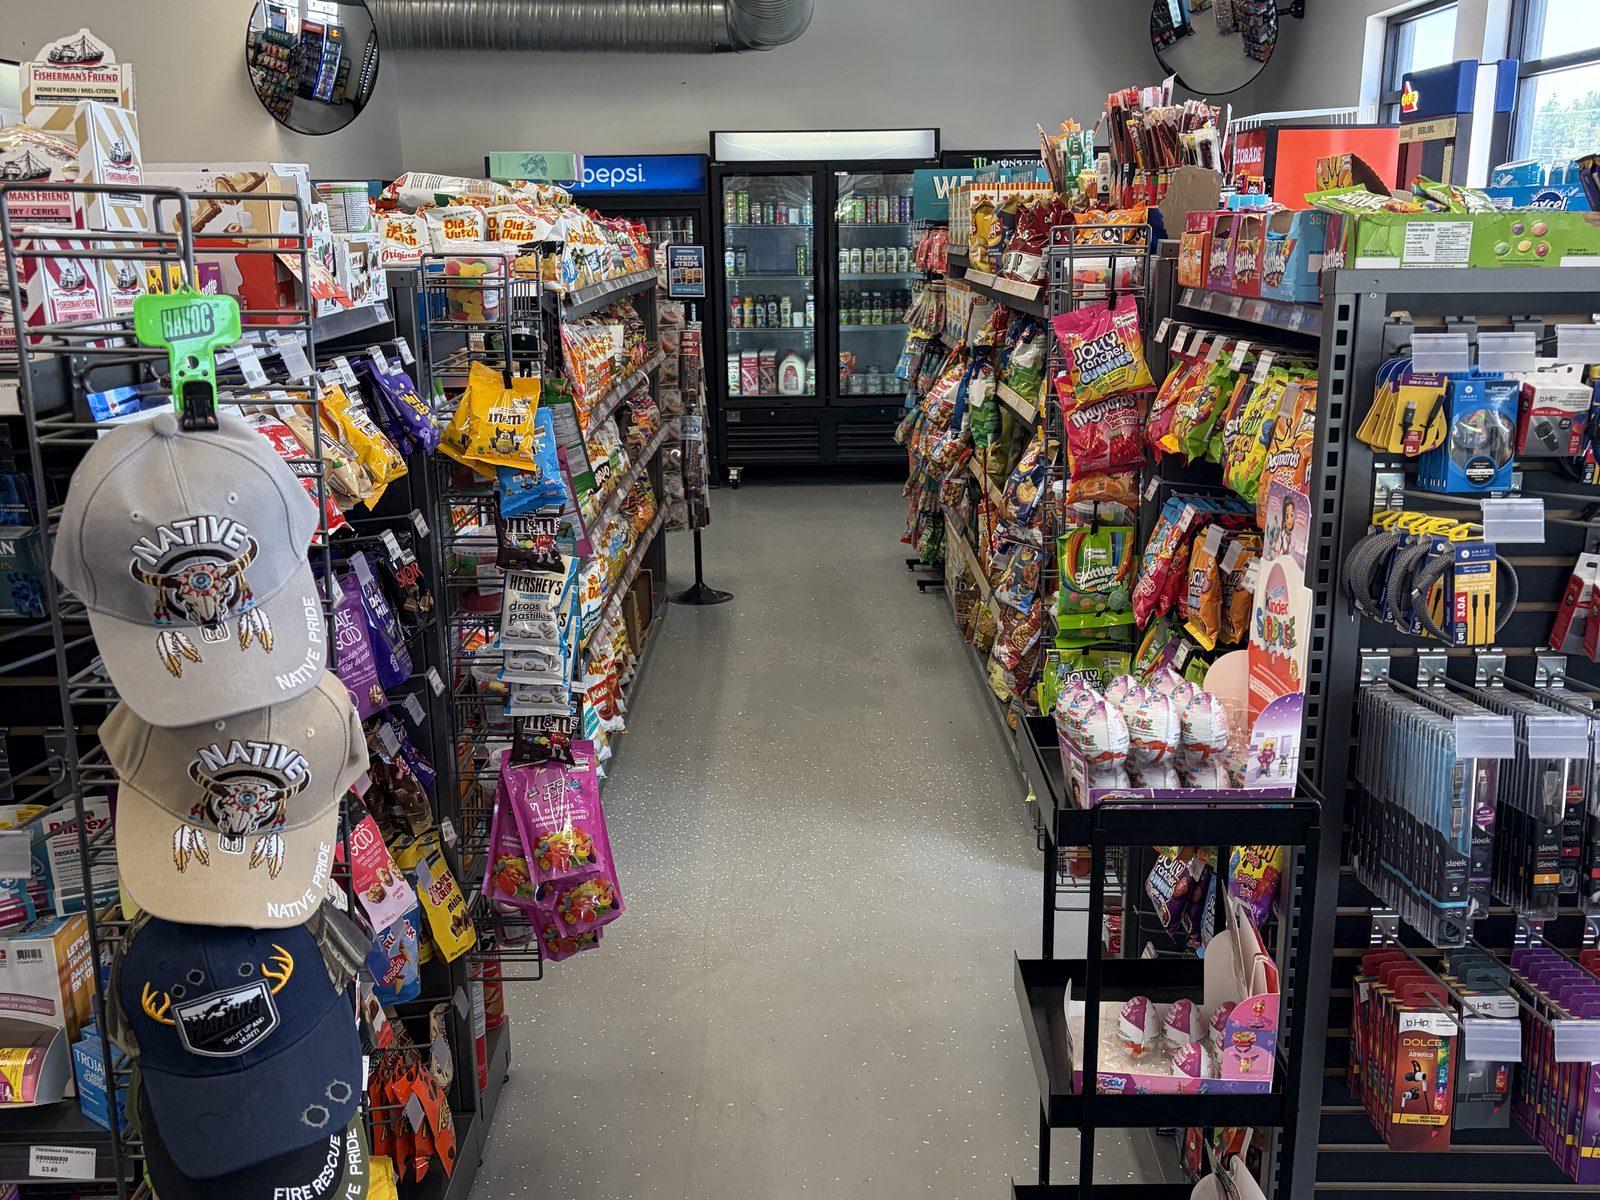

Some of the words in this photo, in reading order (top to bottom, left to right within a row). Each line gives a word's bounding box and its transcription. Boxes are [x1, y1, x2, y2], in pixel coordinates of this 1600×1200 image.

[33, 69, 86, 82] FISHERMAN'S
[87, 71, 119, 83] FRIEND
[81, 87, 116, 95] MIEL-CITRON
[581, 163, 646, 190] pepsi
[37, 191, 70, 202] FRIEND
[1531, 196, 1568, 211] excel
[31, 208, 61, 216] CERISE
[444, 219, 465, 230] Old
[503, 219, 524, 231] Old
[501, 229, 534, 241] Dutch
[381, 249, 423, 262] Original
[1074, 329, 1119, 366] JOLLY
[1080, 343, 1126, 373] rancher
[1080, 352, 1134, 385] GUMMIES
[130, 515, 249, 566] NATIVE
[509, 574, 564, 596] HERSHEY'S
[509, 601, 541, 614] drops
[1457, 595, 1466, 618] 3.0A
[334, 608, 354, 632] ADE
[275, 647, 322, 691] NATIVE
[302, 596, 322, 644] PRIDE
[1457, 632, 1465, 640] 5
[1064, 669, 1099, 685] JOLLY
[198, 740, 310, 782] NATIVE
[54, 849, 81, 858] REGULA
[1538, 844, 1560, 852] sleek
[1445, 858, 1467, 868] sleek
[1536, 860, 1559, 868] sleek
[266, 888, 317, 919] NATIVE
[312, 841, 331, 889] PRIDE
[446, 893, 463, 913] minis
[66, 934, 84, 959] LET'S
[71, 978, 82, 993] EN
[223, 1030, 243, 1045] SHUT
[242, 1023, 253, 1033] UP
[252, 1016, 265, 1028] AND
[347, 1127, 364, 1176] PRIDE
[273, 1184, 313, 1200] FIRE
[312, 1134, 341, 1197] RESCUE
